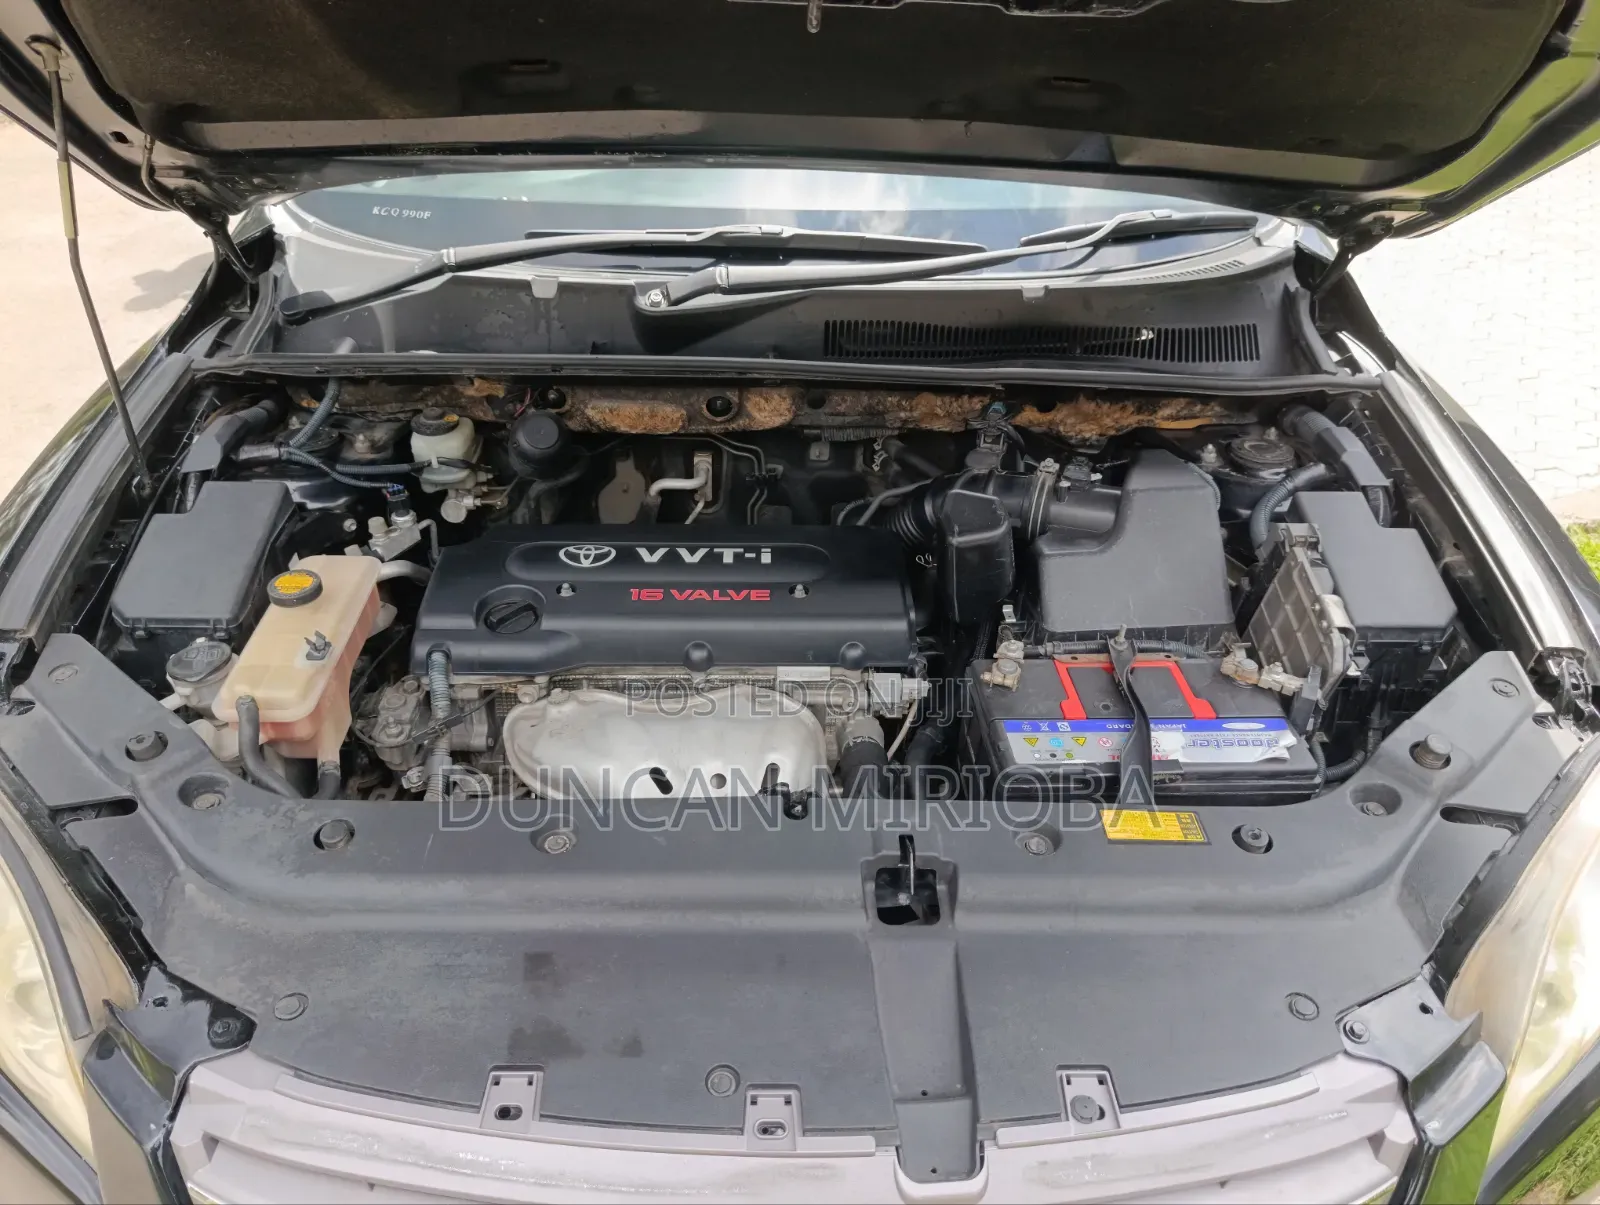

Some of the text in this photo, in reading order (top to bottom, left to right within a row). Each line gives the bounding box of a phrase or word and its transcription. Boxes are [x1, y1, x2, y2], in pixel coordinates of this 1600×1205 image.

[372, 205, 432, 220] KCQ 990F
[635, 547, 772, 564] VVT-i
[630, 588, 771, 601] 16 VALVE
